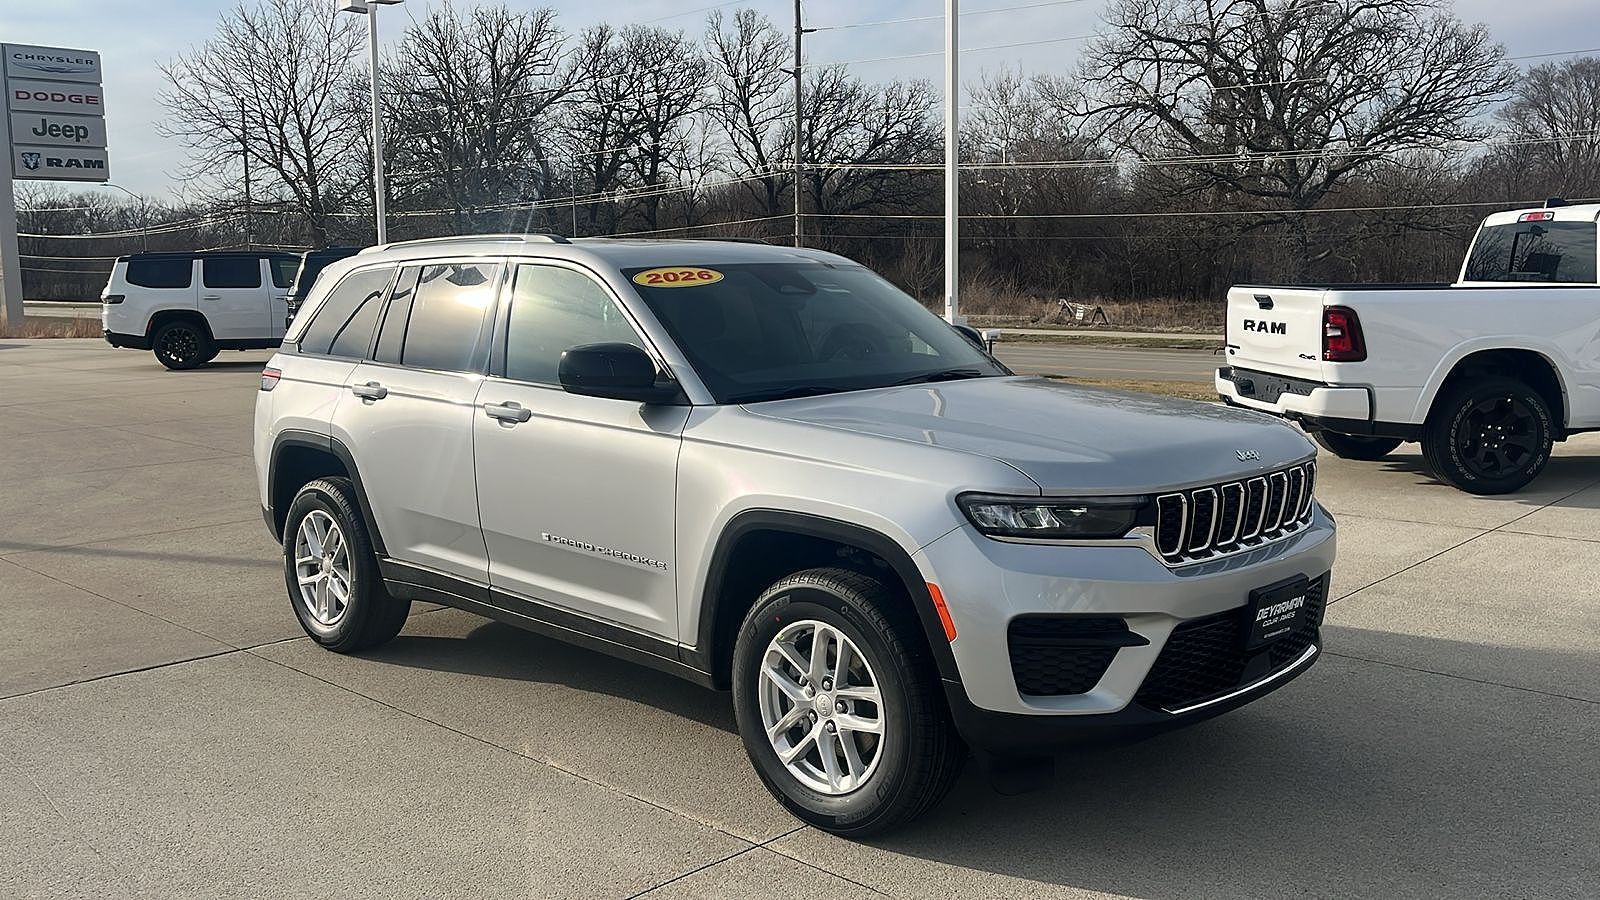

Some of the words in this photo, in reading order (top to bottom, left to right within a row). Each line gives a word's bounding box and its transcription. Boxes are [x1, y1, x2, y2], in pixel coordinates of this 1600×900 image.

[13, 53, 94, 66] CHRYSLER
[15, 90, 99, 105] DODGE
[32, 118, 89, 142] Jeep
[46, 157, 104, 169] RAM
[646, 271, 713, 284] 2026
[1243, 319, 1287, 334] RAM
[1235, 449, 1260, 462] Jeep
[552, 535, 596, 552] GRAND
[597, 546, 668, 571] CHEROKEE
[1255, 595, 1305, 622] DEYARMAN
